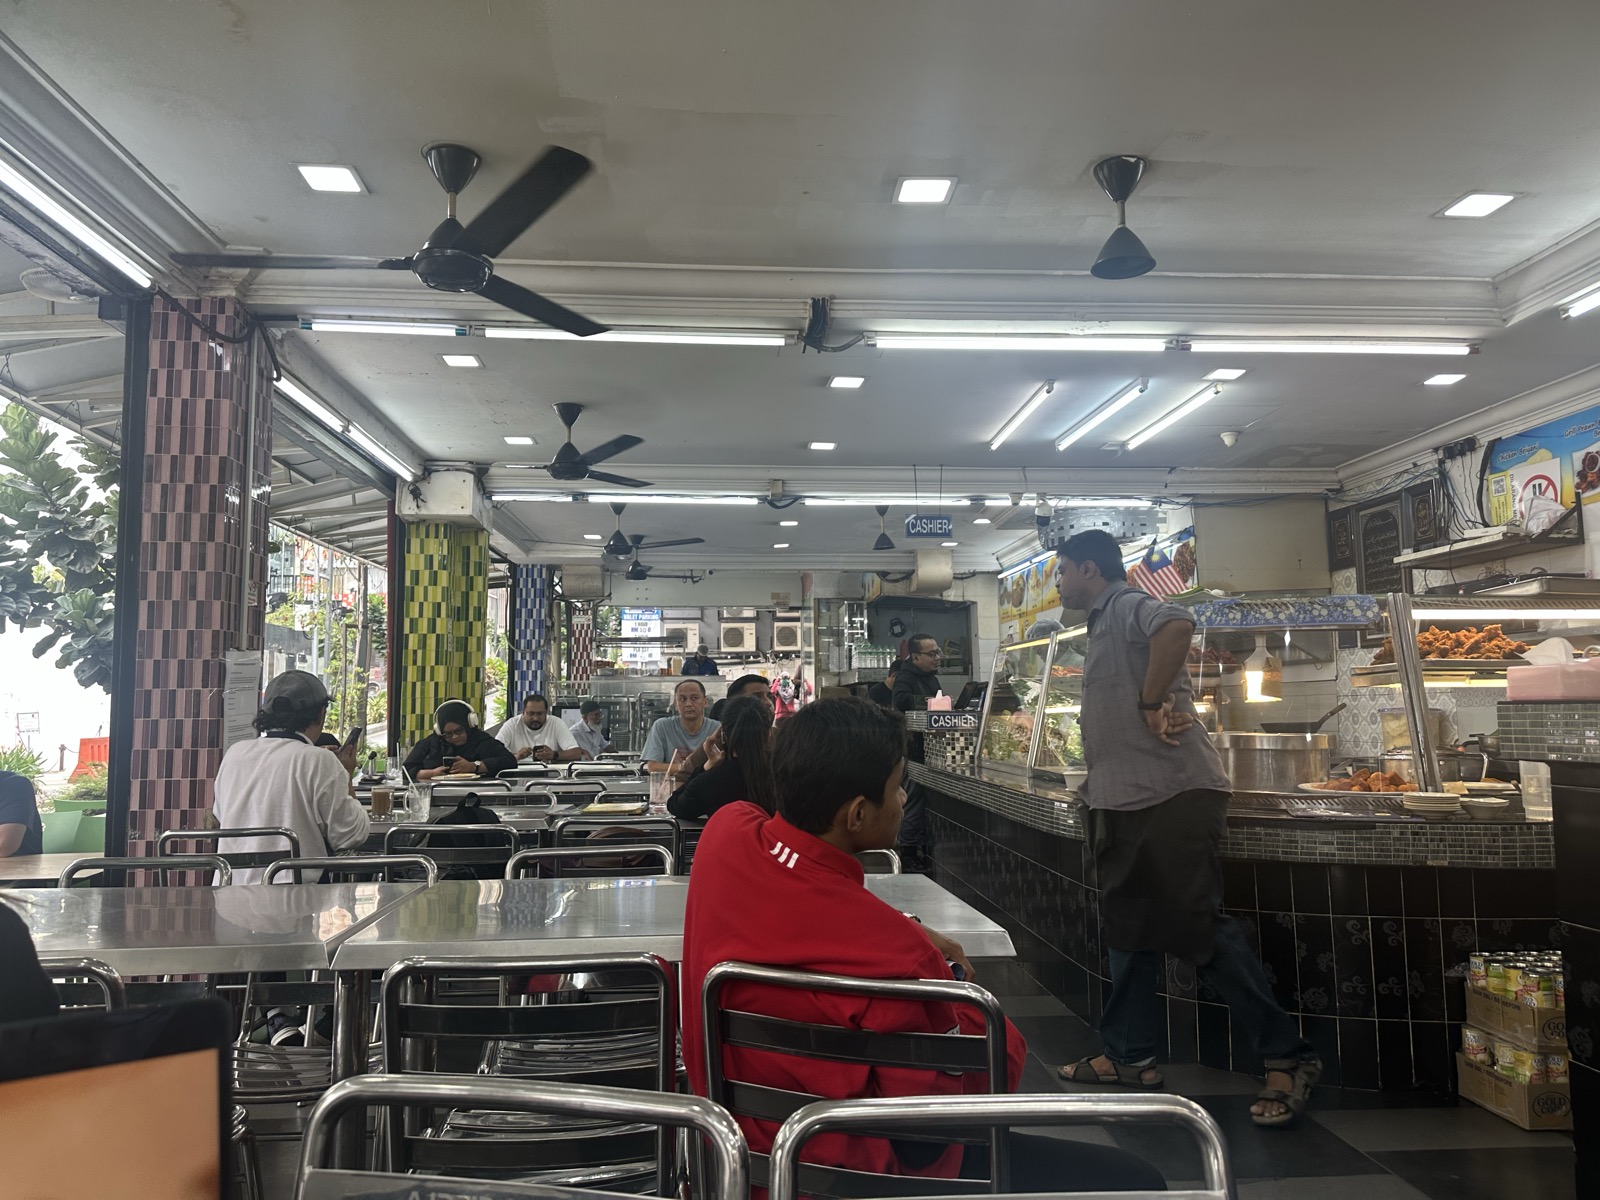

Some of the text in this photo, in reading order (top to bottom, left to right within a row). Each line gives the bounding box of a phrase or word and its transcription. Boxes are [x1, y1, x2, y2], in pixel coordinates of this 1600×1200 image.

[1578, 422, 1595, 432] Prawn
[1498, 451, 1518, 462] Chicken
[909, 519, 949, 533] CASHIER
[932, 715, 974, 727] CASHIER
[1548, 1022, 1564, 1030] GO
[1538, 1098, 1566, 1107] GOLD
